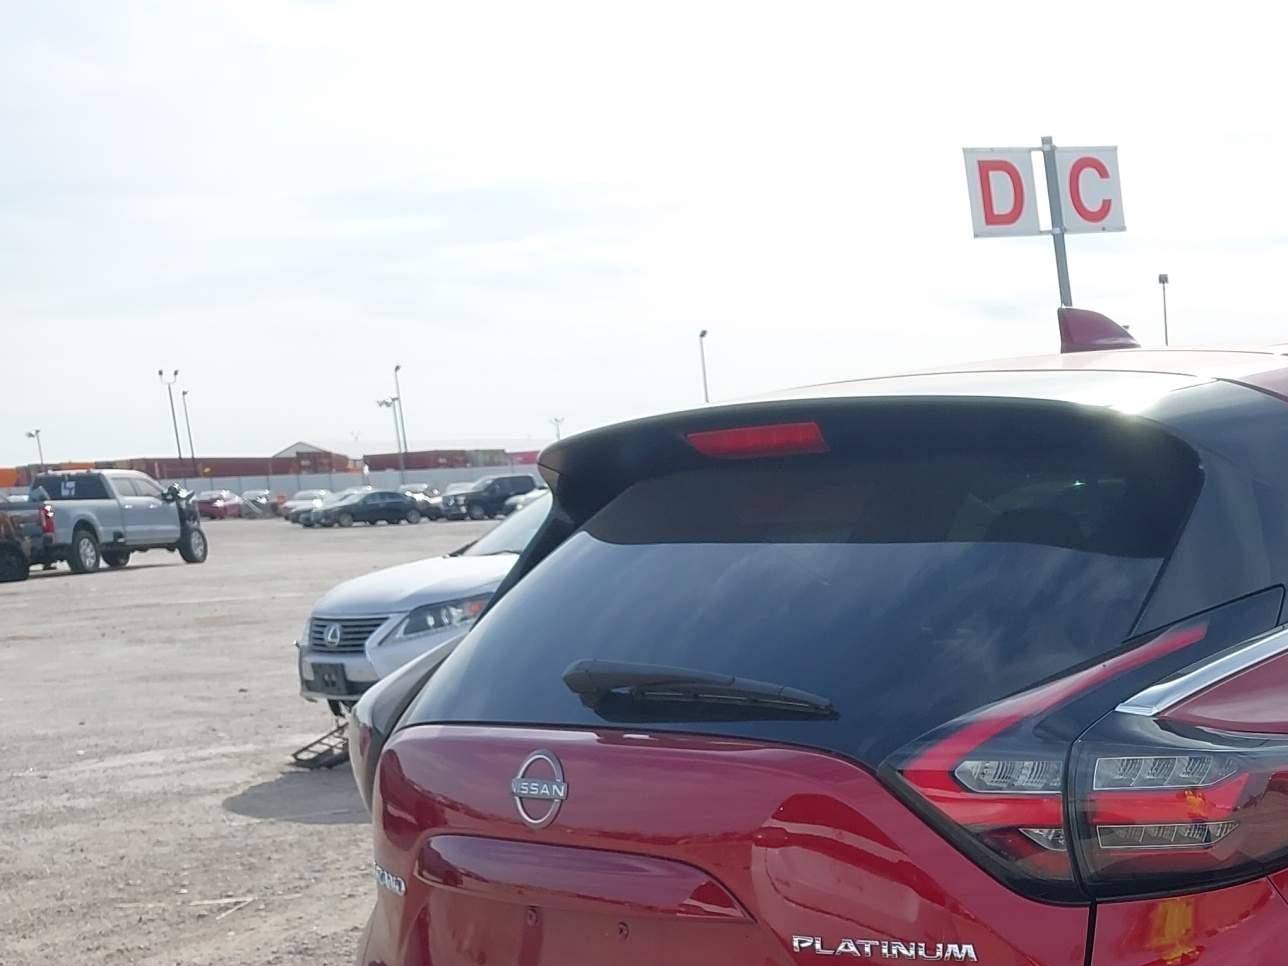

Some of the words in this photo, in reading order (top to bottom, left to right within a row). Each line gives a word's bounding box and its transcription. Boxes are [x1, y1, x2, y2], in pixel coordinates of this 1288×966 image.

[977, 159, 1025, 226] D
[1069, 156, 1112, 223] C
[792, 935, 979, 962] PLATINUM
